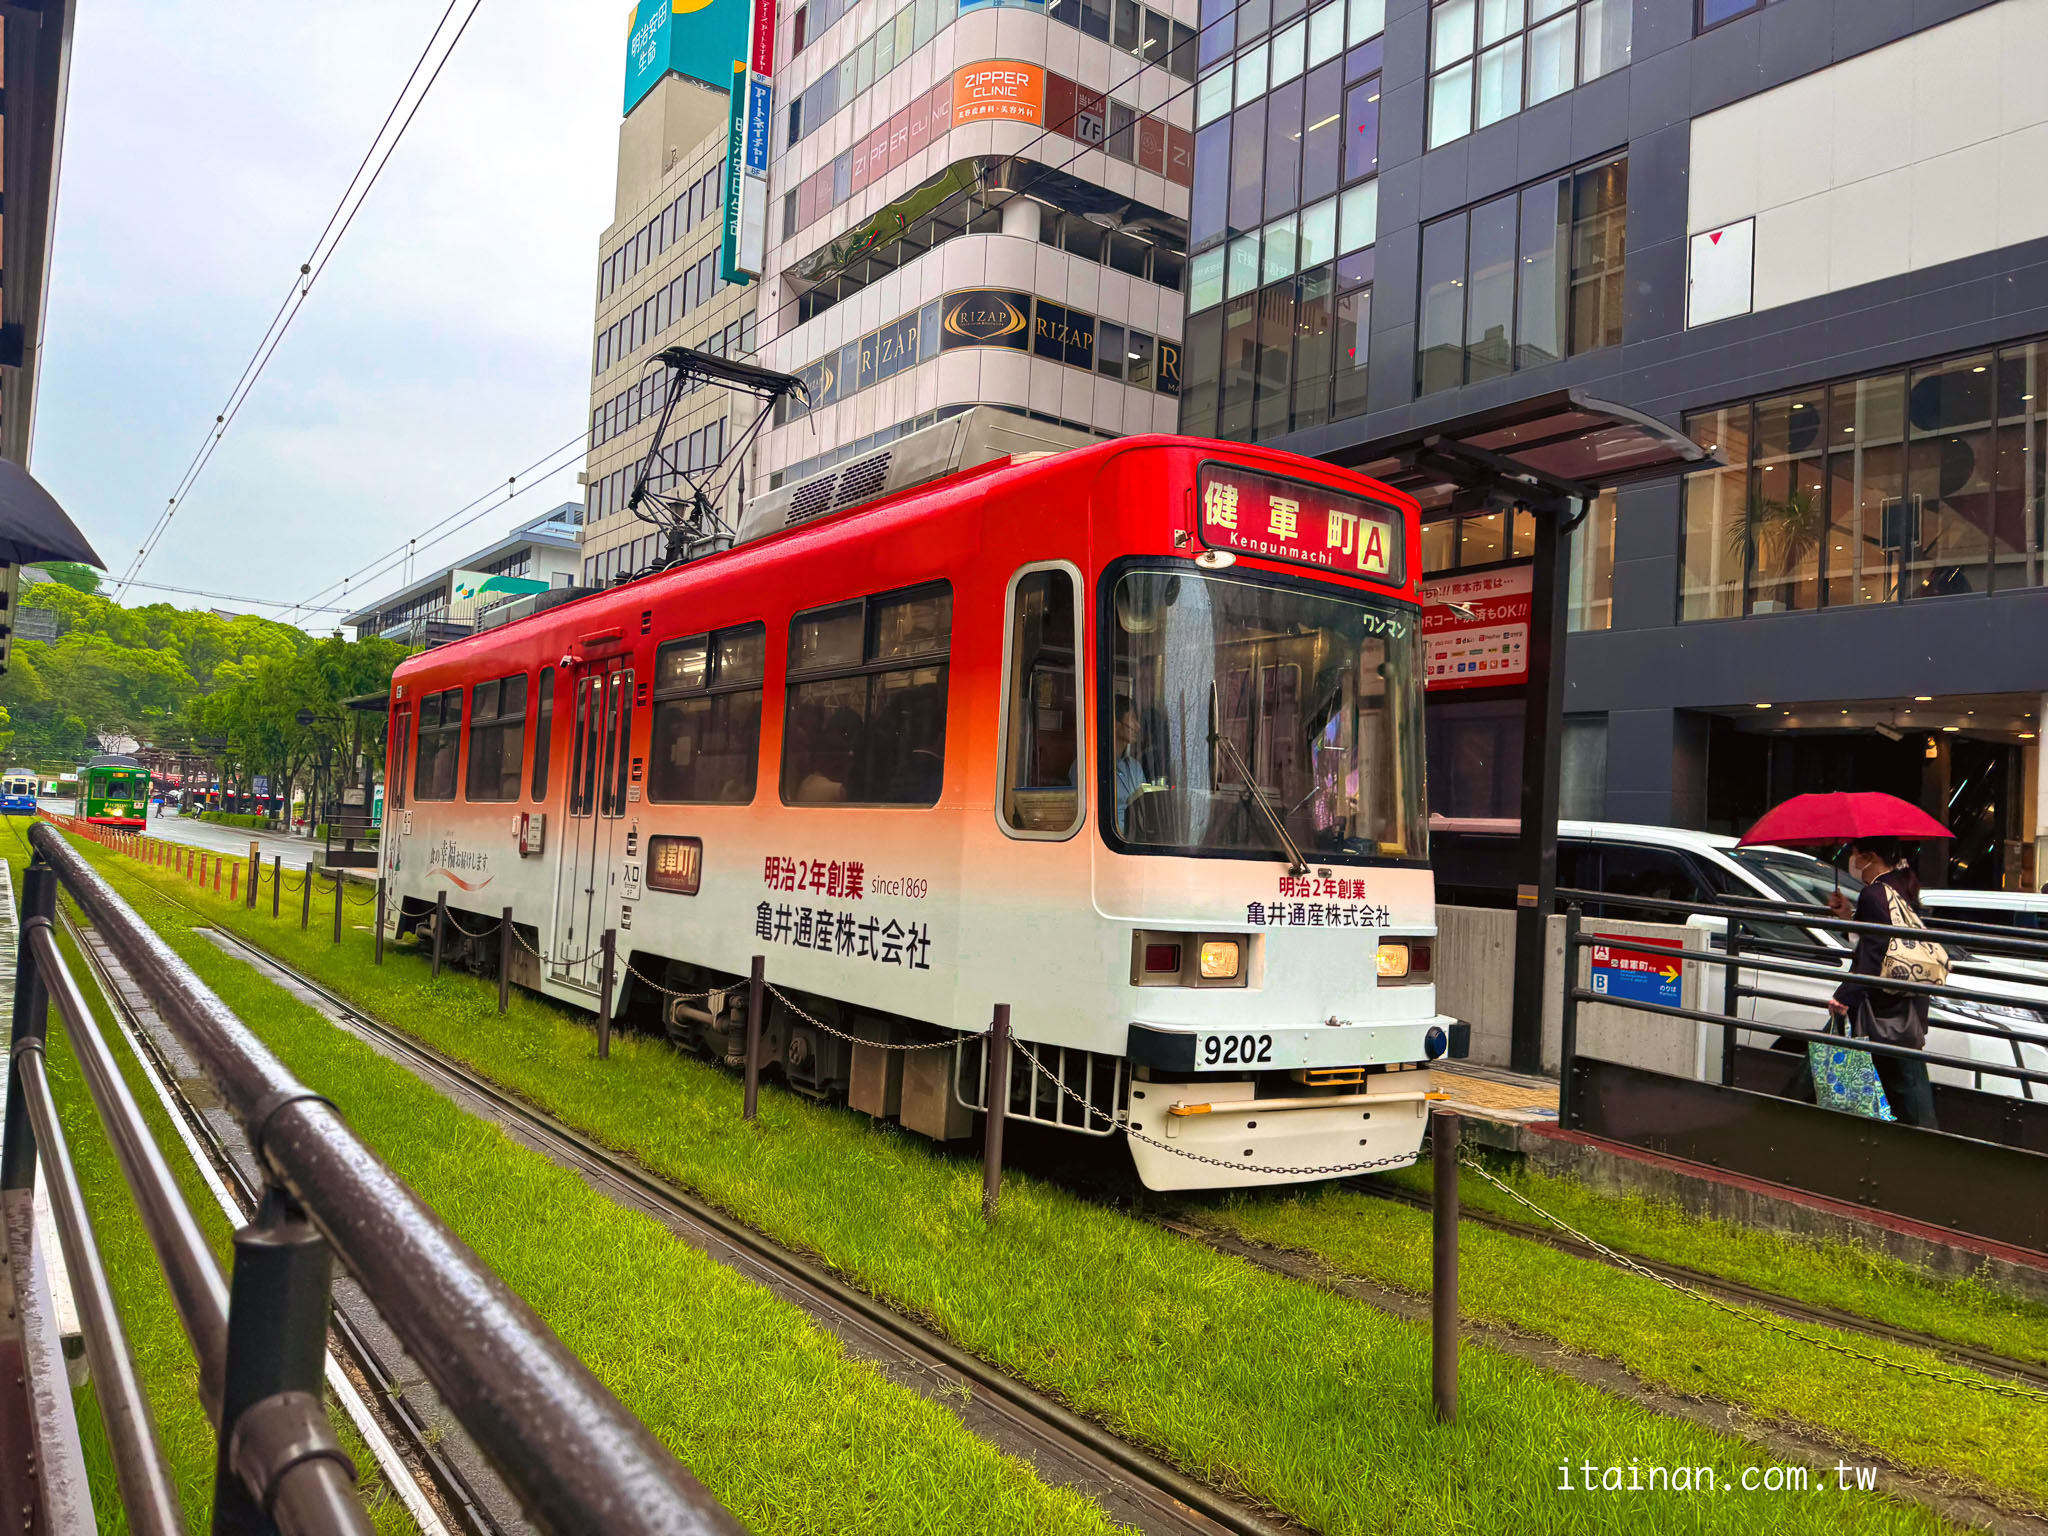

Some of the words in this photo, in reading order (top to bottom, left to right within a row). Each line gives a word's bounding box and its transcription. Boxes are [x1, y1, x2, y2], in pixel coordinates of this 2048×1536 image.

[632, 0, 668, 57] 明治安田
[638, 40, 656, 76] 生命
[964, 71, 1029, 88] ZIPPER
[973, 86, 1017, 98] CLINIC
[855, 126, 908, 176] ZIPPER
[912, 101, 950, 136] CLINIC
[1080, 115, 1101, 139] 7F
[960, 311, 1007, 322] RIZAP
[1036, 318, 1093, 350] RIZAP
[861, 327, 917, 373] RIZAP
[1230, 531, 1332, 564] Kengunmachi
[1363, 614, 1406, 639] ワンマン
[623, 865, 639, 882] 入口
[764, 856, 864, 900] 明治2年創業
[1279, 876, 1366, 900] 明治2年創業
[1246, 901, 1390, 928] 亀井通産株式会社
[756, 900, 931, 970] 亀井通産株式会社
[1596, 976, 1605, 988] B
[1205, 1035, 1272, 1065] 9202
